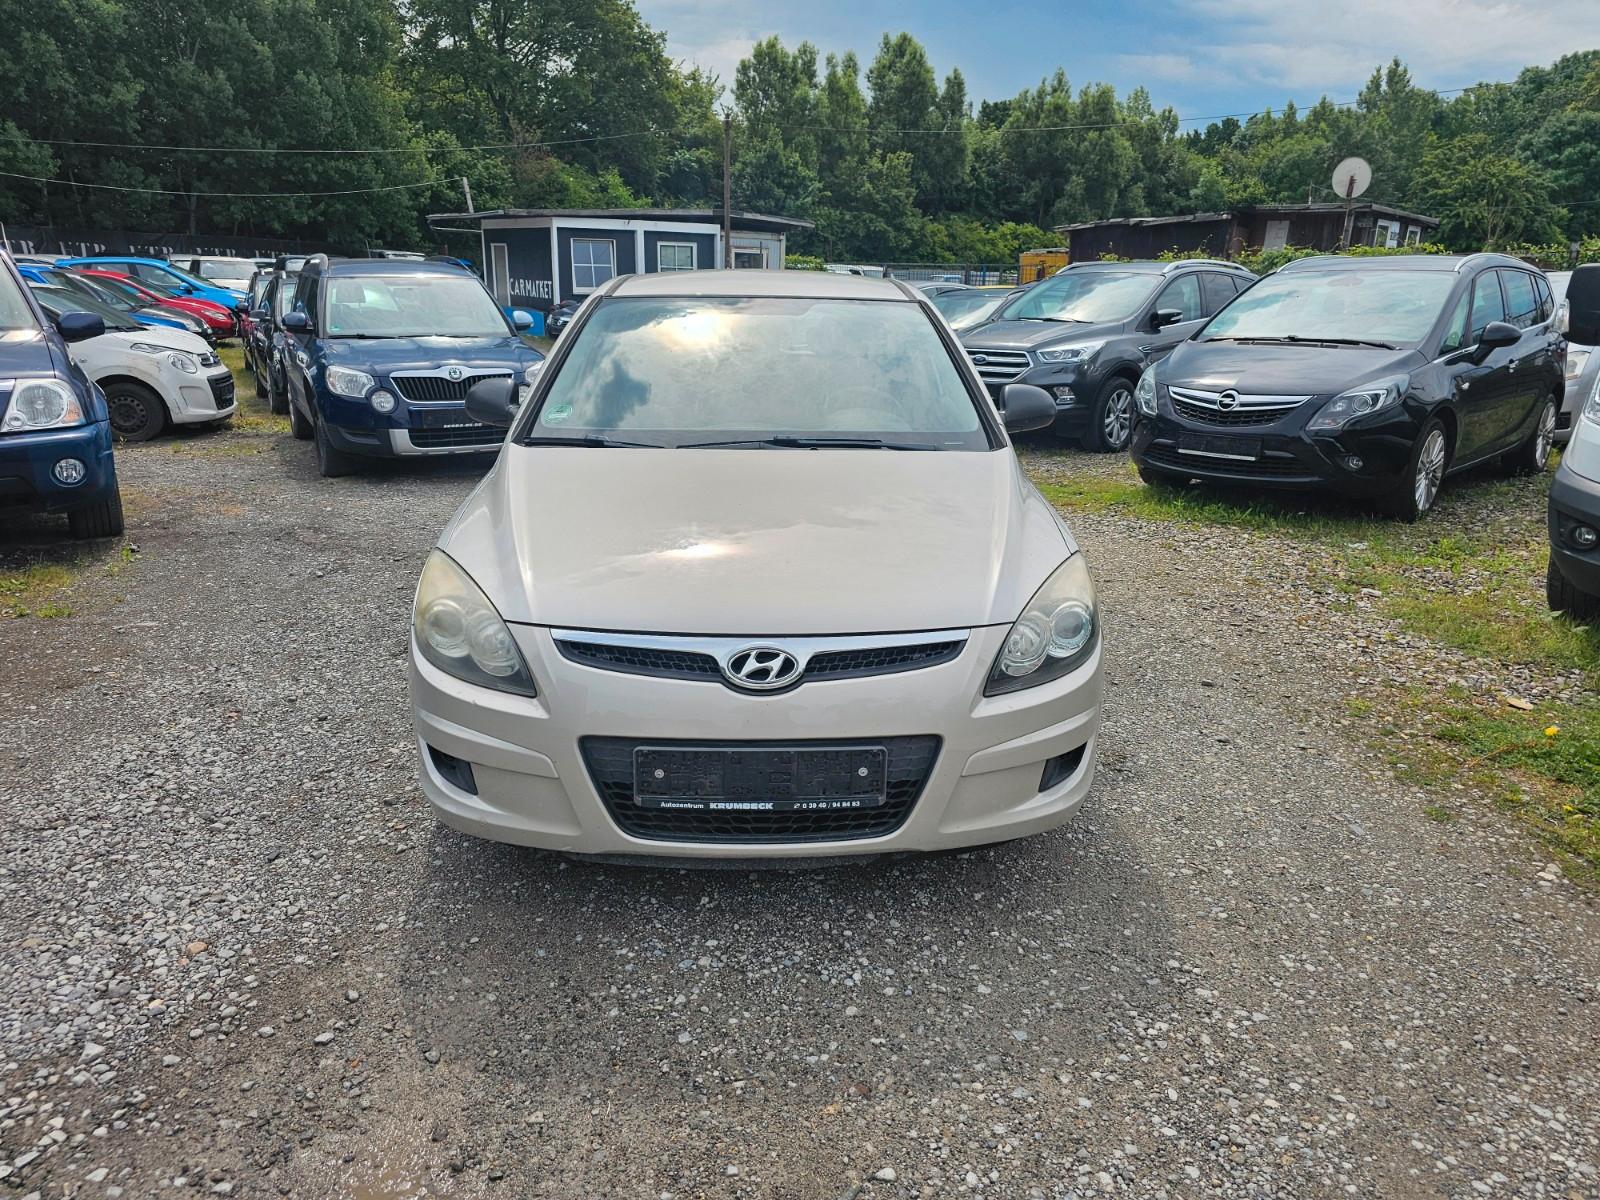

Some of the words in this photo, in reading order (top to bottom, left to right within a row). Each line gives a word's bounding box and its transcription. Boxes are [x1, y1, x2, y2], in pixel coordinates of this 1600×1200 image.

[509, 278, 552, 299] CARMARKET
[660, 801, 704, 809] Autozentrum
[709, 802, 774, 810] KRUMBECK
